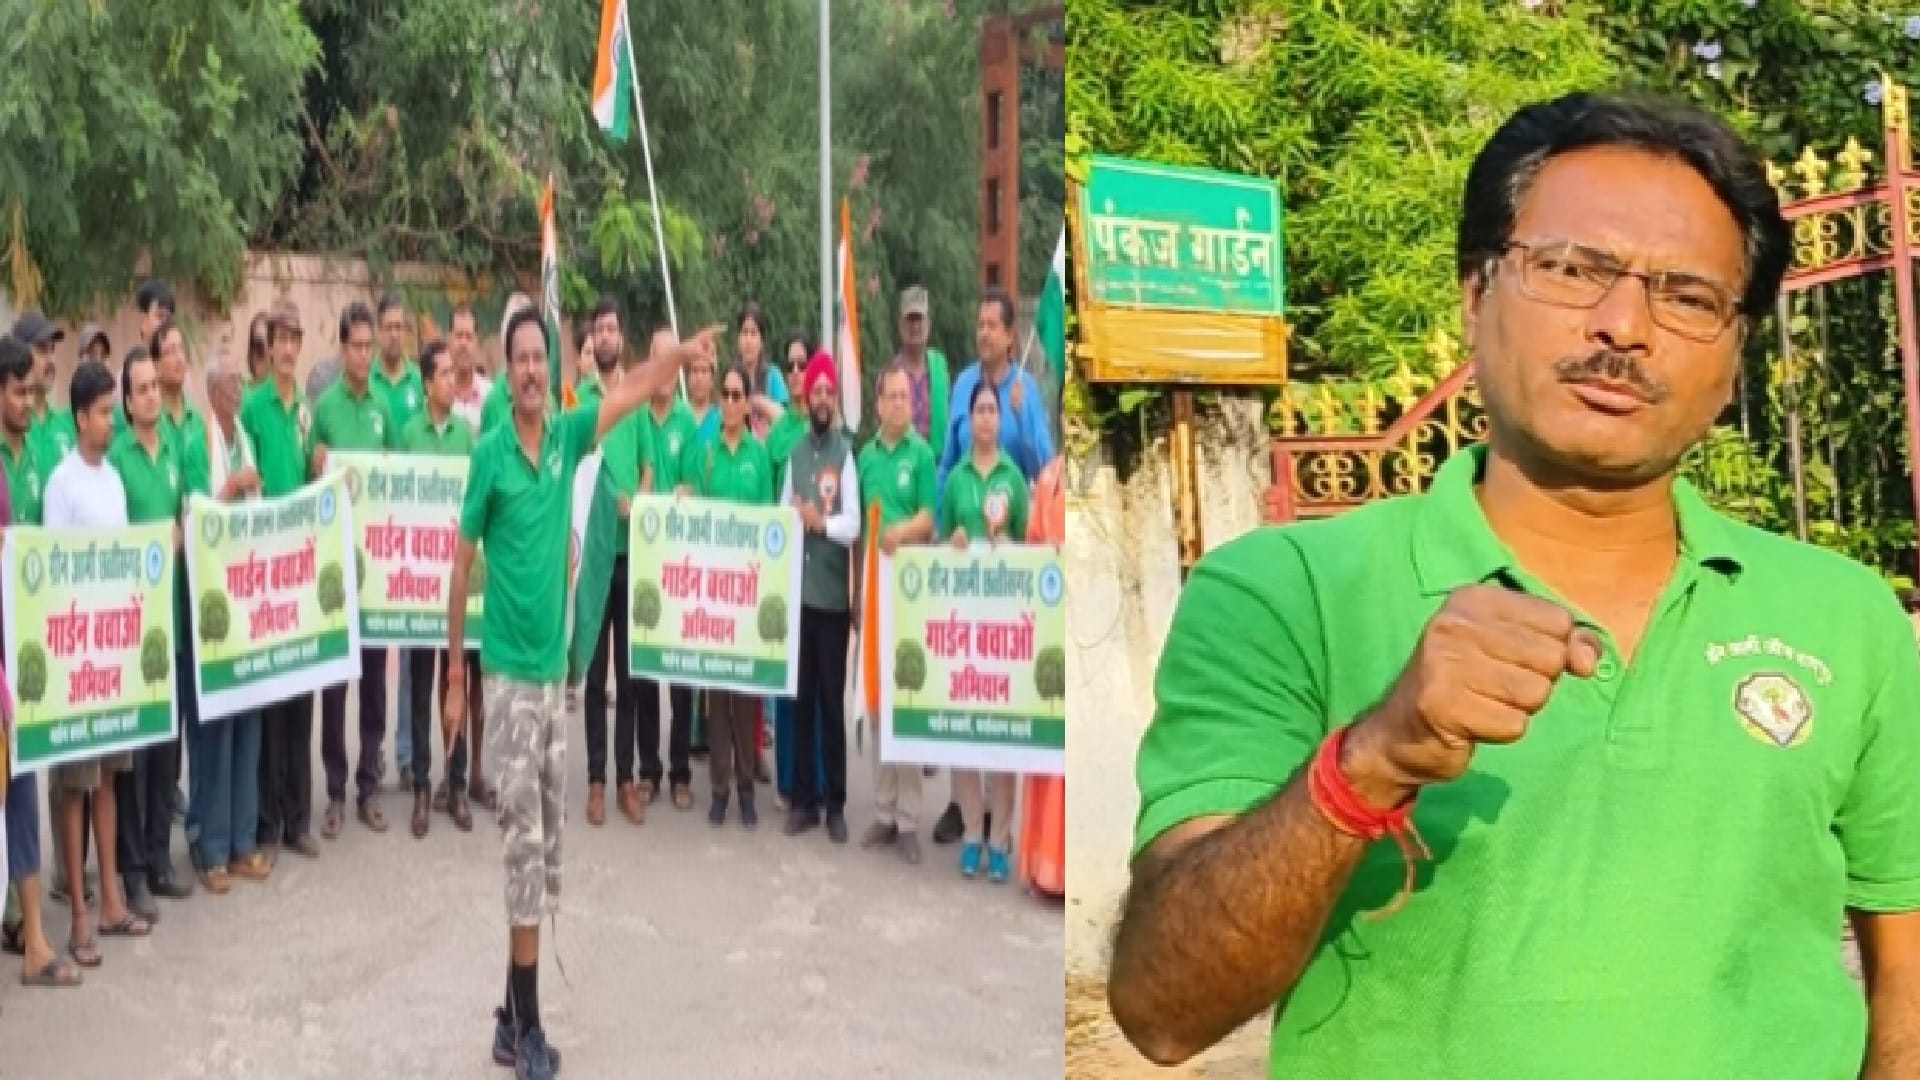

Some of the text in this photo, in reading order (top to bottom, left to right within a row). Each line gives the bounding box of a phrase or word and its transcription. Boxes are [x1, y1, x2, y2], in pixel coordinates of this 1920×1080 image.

[1091, 197, 1273, 277] पंकज गार्डन
[365, 514, 406, 561] गार्डन
[226, 549, 267, 600] गार्डन
[387, 566, 441, 603] अभियान
[662, 554, 703, 599] गार्डन
[46, 599, 90, 657] गार्डन
[248, 599, 299, 641] अभियान
[681, 606, 736, 645] अभियान
[926, 609, 972, 658] गार्डन
[68, 660, 122, 706] अभियान
[949, 664, 1011, 704] अभियान
